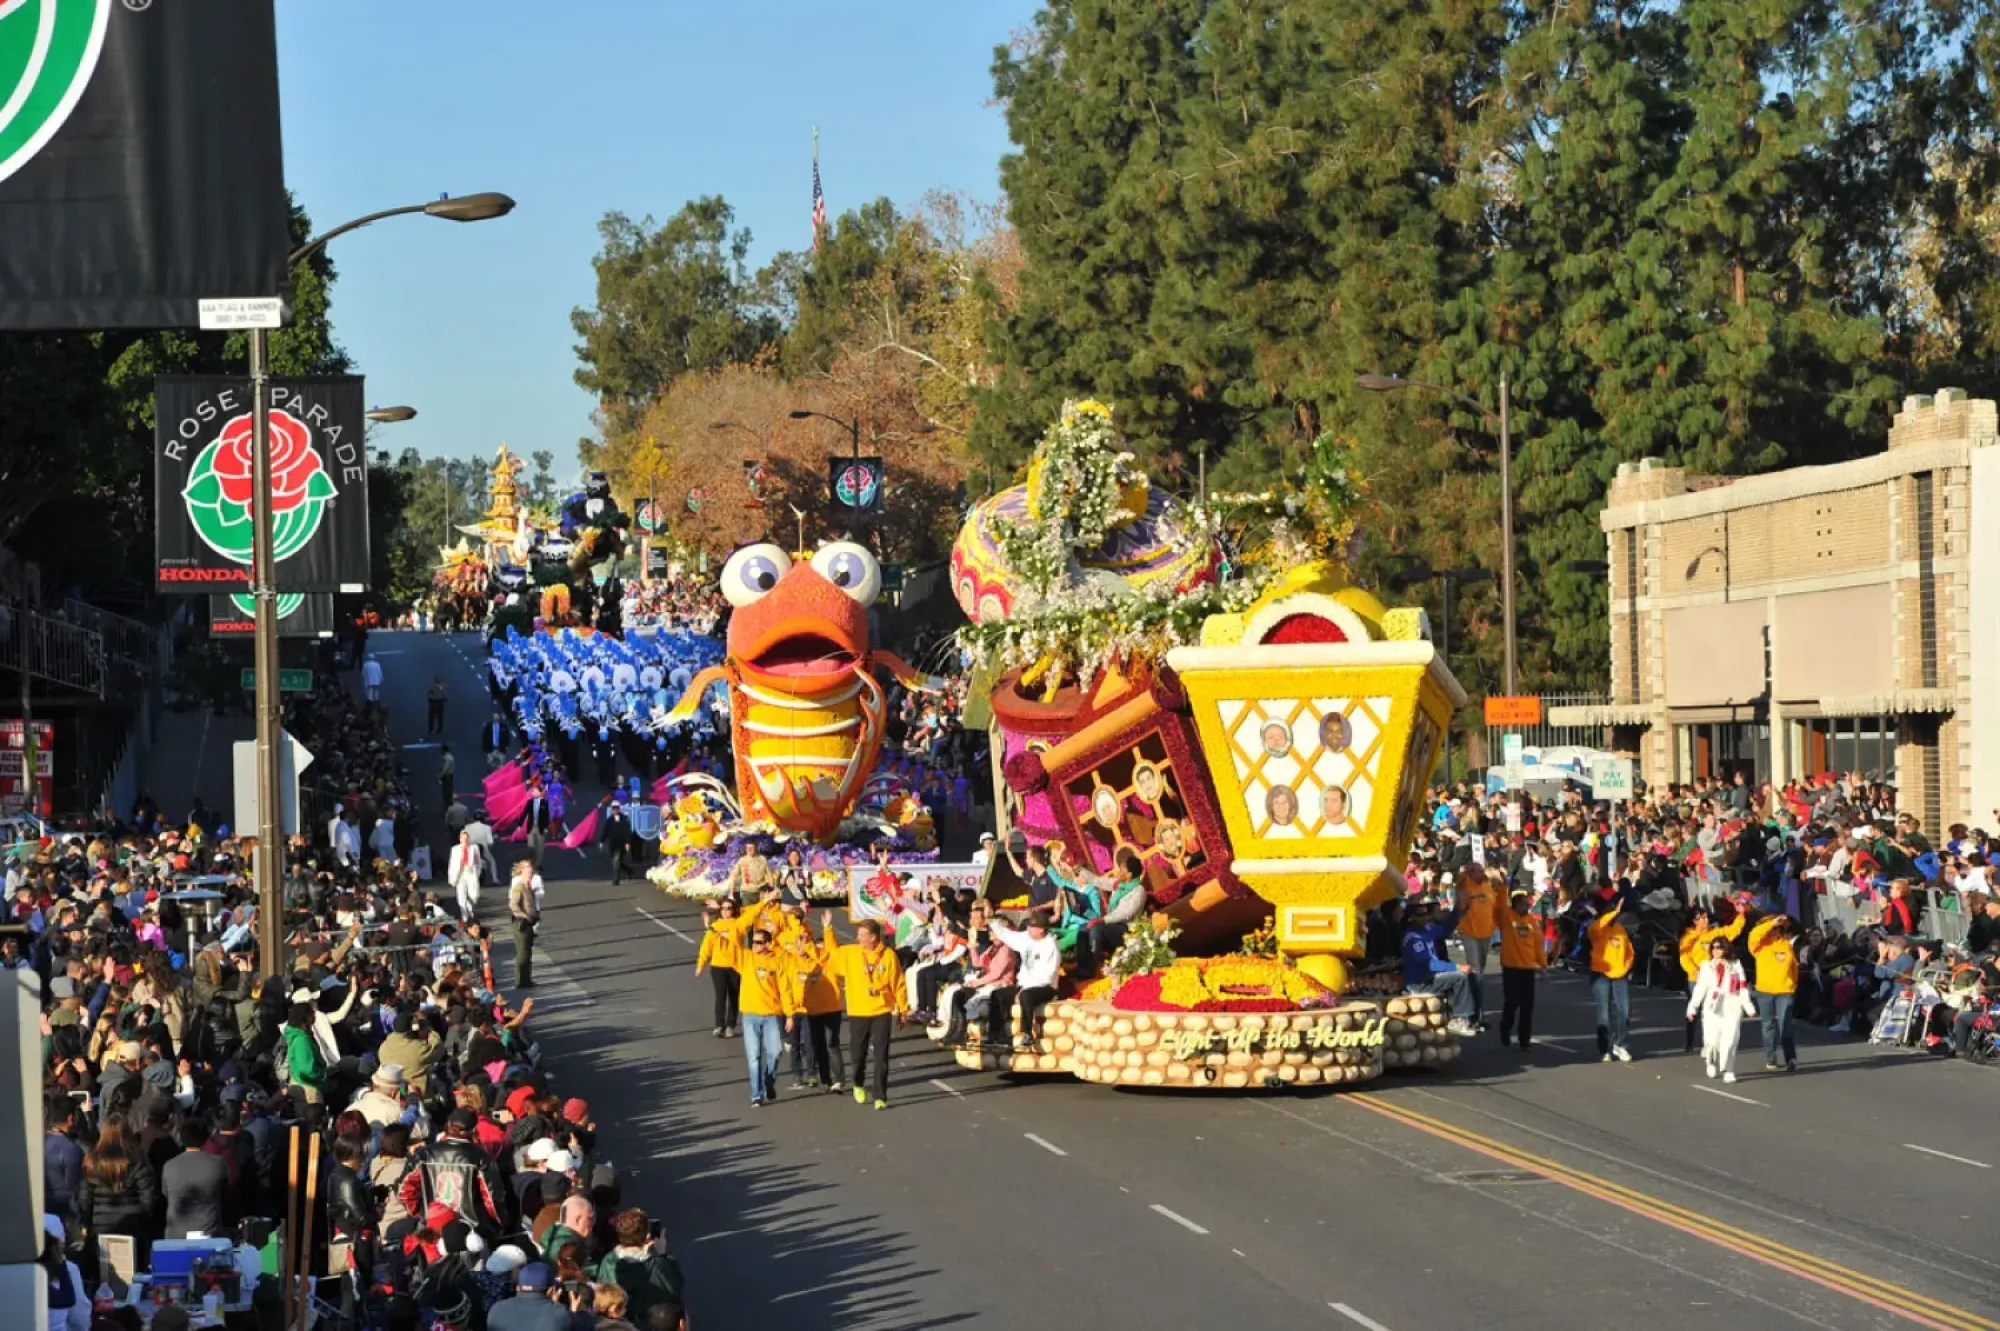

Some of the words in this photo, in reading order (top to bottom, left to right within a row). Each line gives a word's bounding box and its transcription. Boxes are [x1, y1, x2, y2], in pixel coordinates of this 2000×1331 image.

[164, 388, 240, 461] ROSE
[271, 387, 364, 485] PARADE
[159, 567, 249, 581] HONDA
[1603, 771, 1621, 780] PAY
[1600, 780, 1625, 788] HERE
[1158, 1027, 1214, 1060] Light
[1264, 1027, 1300, 1050] the
[1306, 1017, 1389, 1048] World
